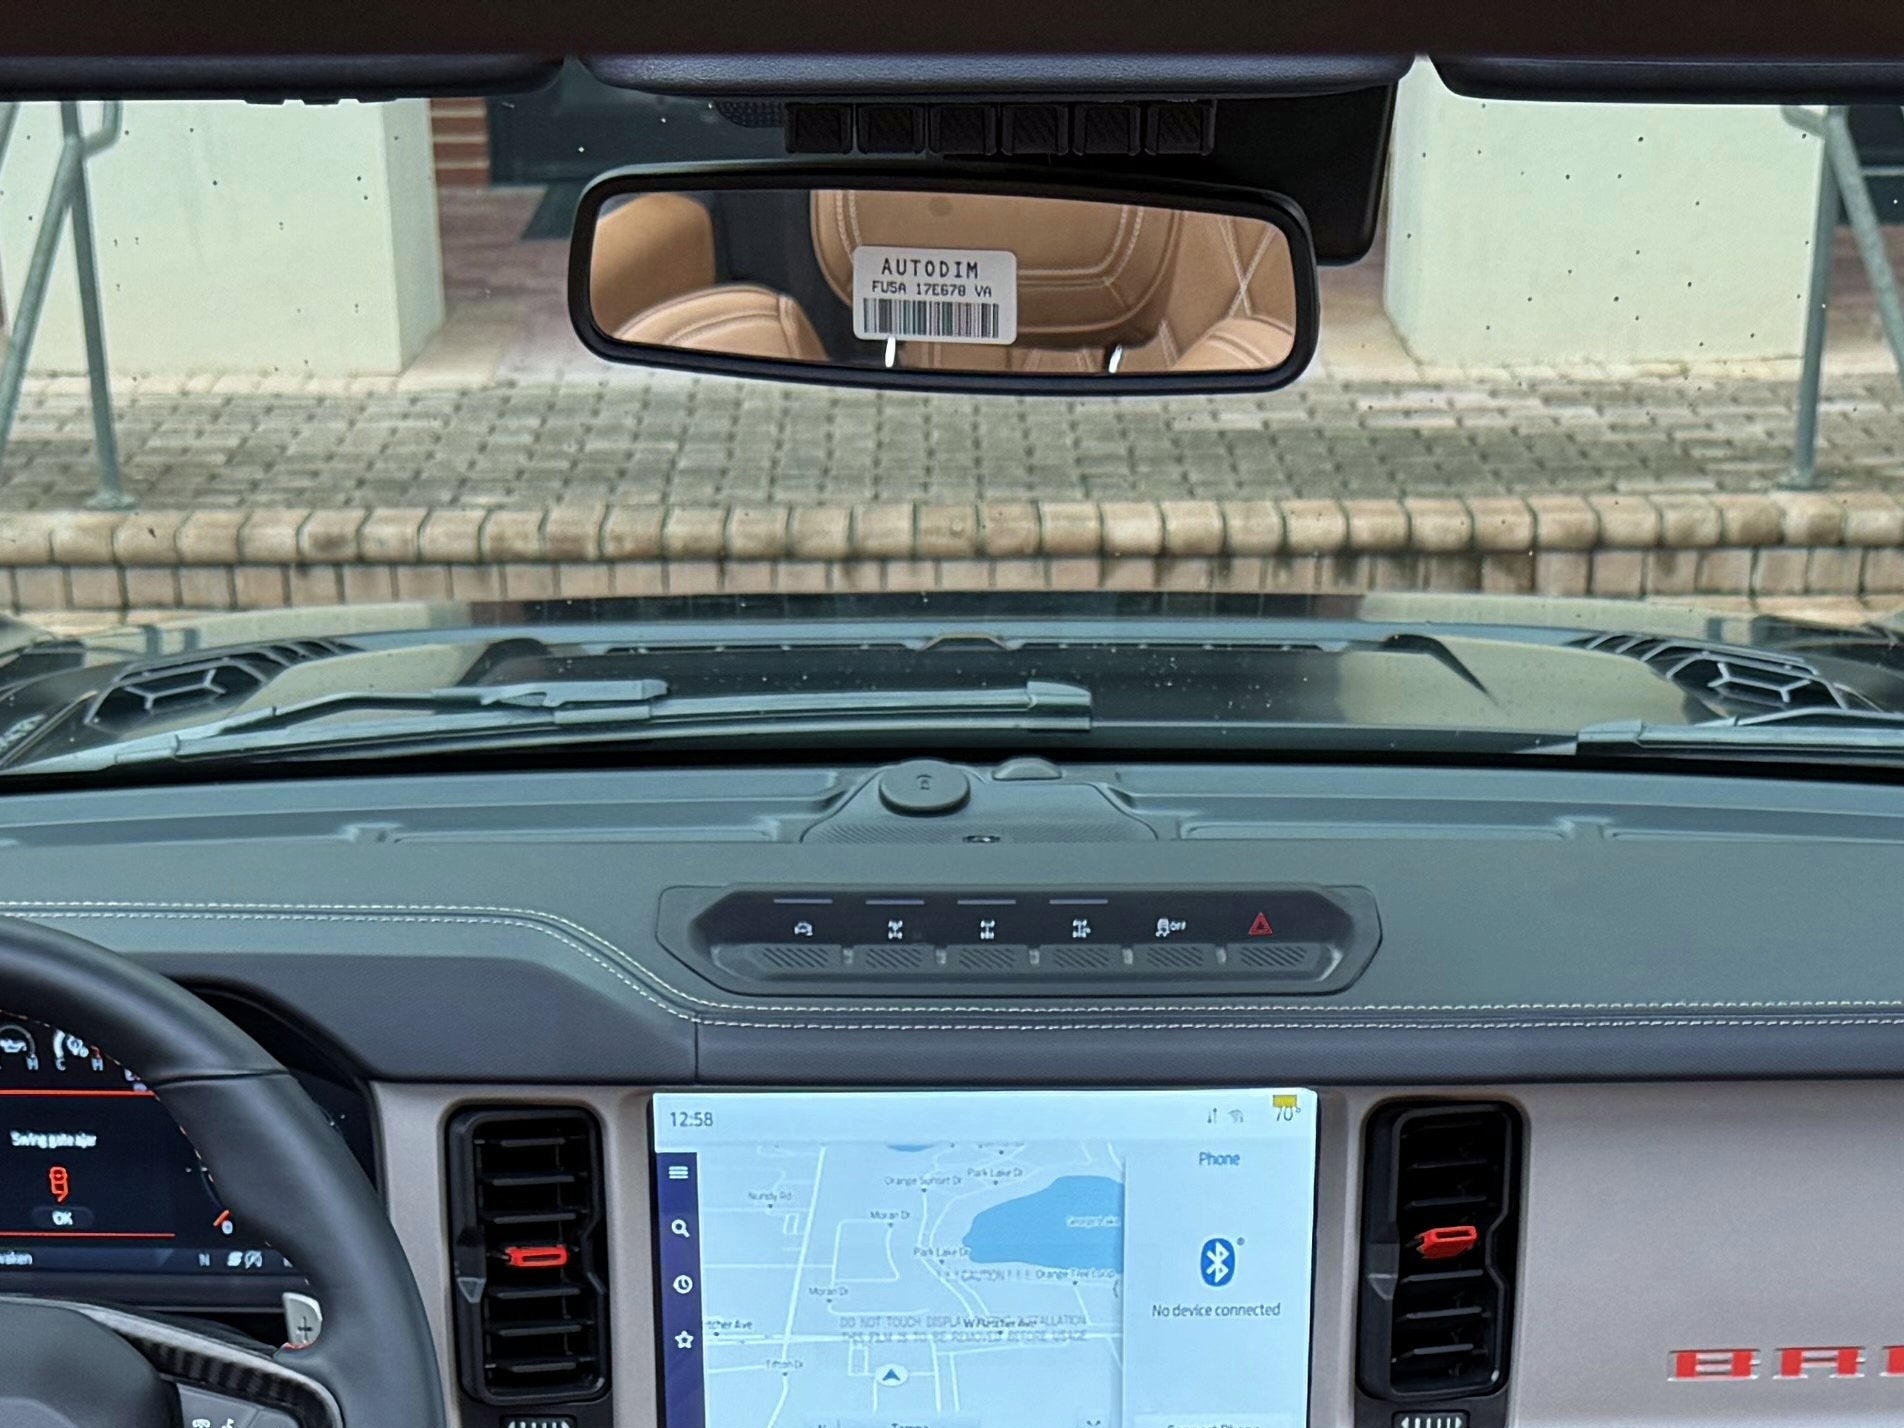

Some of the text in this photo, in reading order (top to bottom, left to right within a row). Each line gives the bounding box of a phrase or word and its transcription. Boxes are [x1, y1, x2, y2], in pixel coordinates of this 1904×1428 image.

[881, 258, 978, 279] AUTODIM
[974, 286, 992, 298] VA
[670, 1111, 714, 1127] 12:58
[1199, 1152, 1240, 1166] Phone
[52, 1211, 73, 1226] OK
[1152, 1302, 1281, 1317] No device connected
